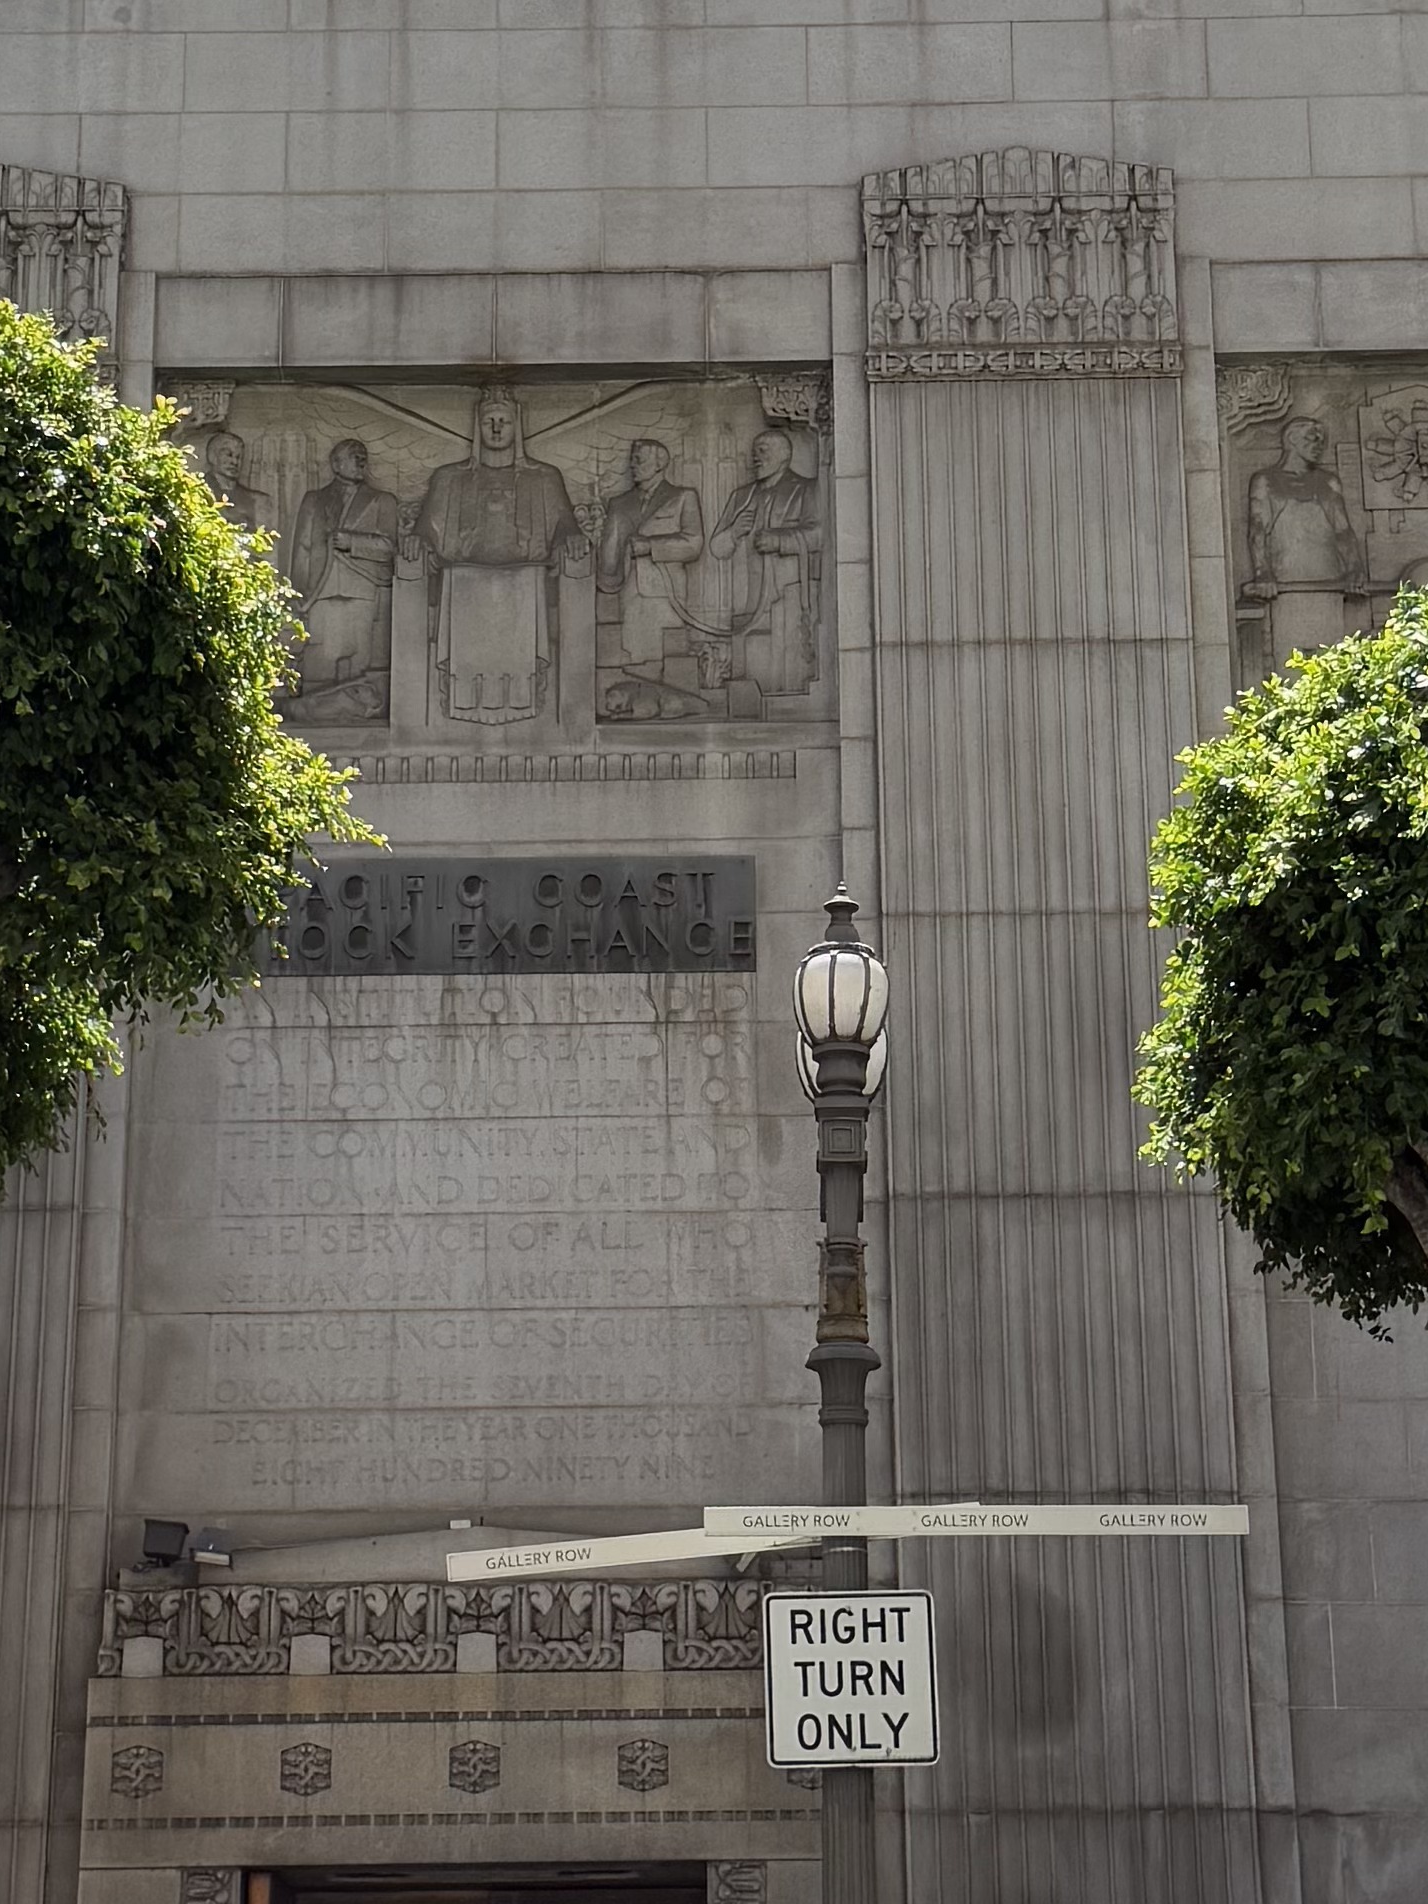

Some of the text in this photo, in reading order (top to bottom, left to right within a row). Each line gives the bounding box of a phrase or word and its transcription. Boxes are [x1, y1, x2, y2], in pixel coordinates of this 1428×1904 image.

[533, 871, 714, 909] COAST
[264, 918, 754, 961] TOCK EXCHANGE
[294, 986, 538, 1020] INSTITUTION
[554, 984, 749, 1018] FOUNDED
[225, 1031, 752, 1068] ON INTEGRITY CREATED FOR
[224, 1076, 750, 1112] THE ECONOMIC WELFARE OF
[222, 1129, 294, 1160] THE
[552, 1126, 660, 1157] STATE
[668, 1124, 752, 1156] AND
[218, 1176, 366, 1208] NATION
[476, 1173, 687, 1204] DEDICATED
[698, 1170, 752, 1201] TO
[220, 1218, 753, 1256] THE SERVICE OF ALL WHO
[362, 1270, 454, 1302] OPEN
[475, 1269, 600, 1300] MARKET
[608, 1268, 675, 1299] FOR
[684, 1267, 753, 1298] THE
[213, 1315, 754, 1353] INTERCHANGE OF SECURITIES
[213, 1371, 756, 1405] ORGANIZED THE SEVENTH DAY OF
[213, 1414, 756, 1445] DECEMBER IN THE YEAR ONE THOUSAND
[251, 1453, 717, 1487] EIGHT HUNDRED NINETY NINE
[741, 1513, 851, 1529] GALLERY ROW
[920, 1512, 1029, 1528] GALLERY ROW
[1098, 1512, 1208, 1528] GALLERY ROW
[485, 1547, 592, 1570] GALLERY ROW
[789, 1606, 912, 1645] RIGHT
[792, 1659, 906, 1698] TURN
[796, 1711, 910, 1751] ONLY
